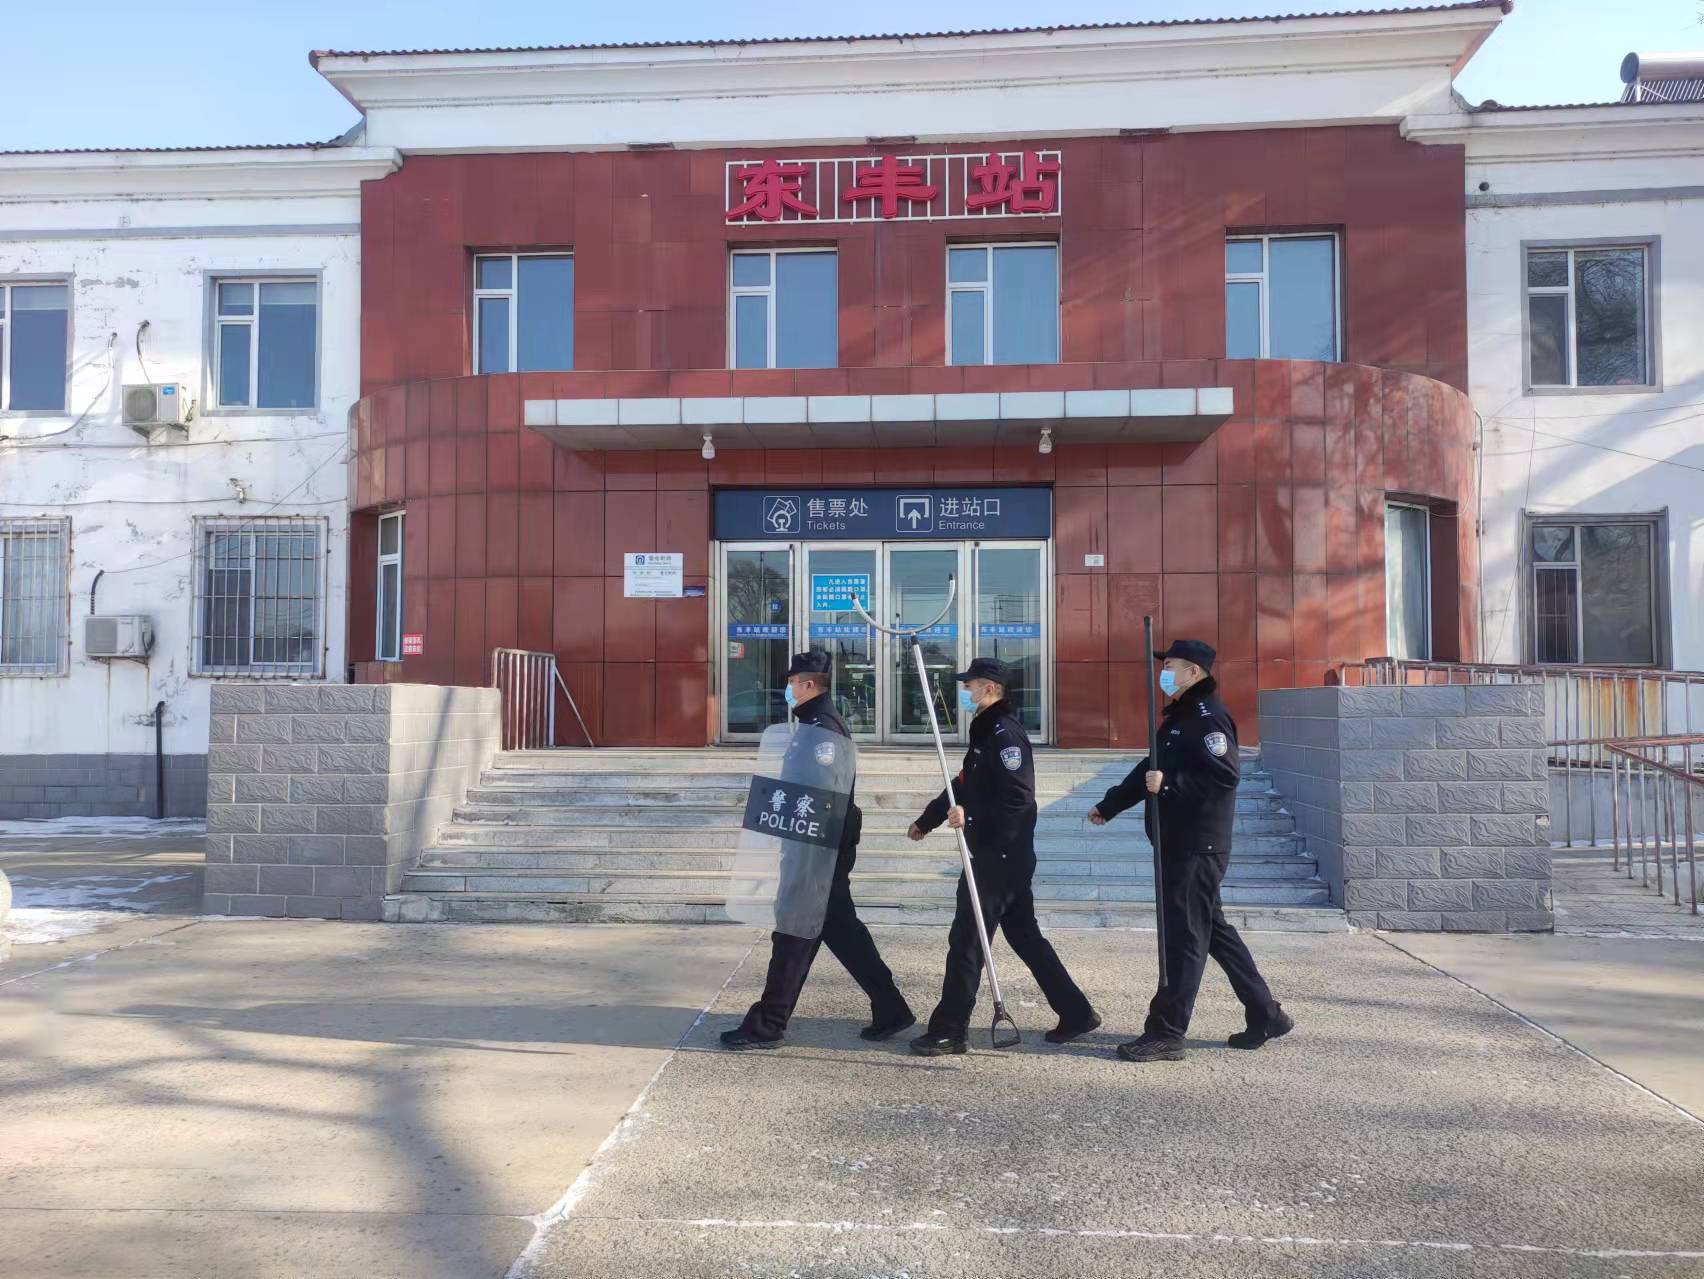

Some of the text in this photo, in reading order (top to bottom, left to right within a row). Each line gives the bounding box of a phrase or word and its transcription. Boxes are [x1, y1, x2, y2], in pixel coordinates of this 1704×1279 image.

[725, 151, 1061, 222] 东丰站
[807, 497, 869, 517] 售票处
[939, 497, 1001, 517] 进站口
[807, 520, 846, 530] Tickets
[938, 520, 985, 530] Entrance
[768, 789, 816, 818] 警察
[759, 811, 820, 837] POLICE
